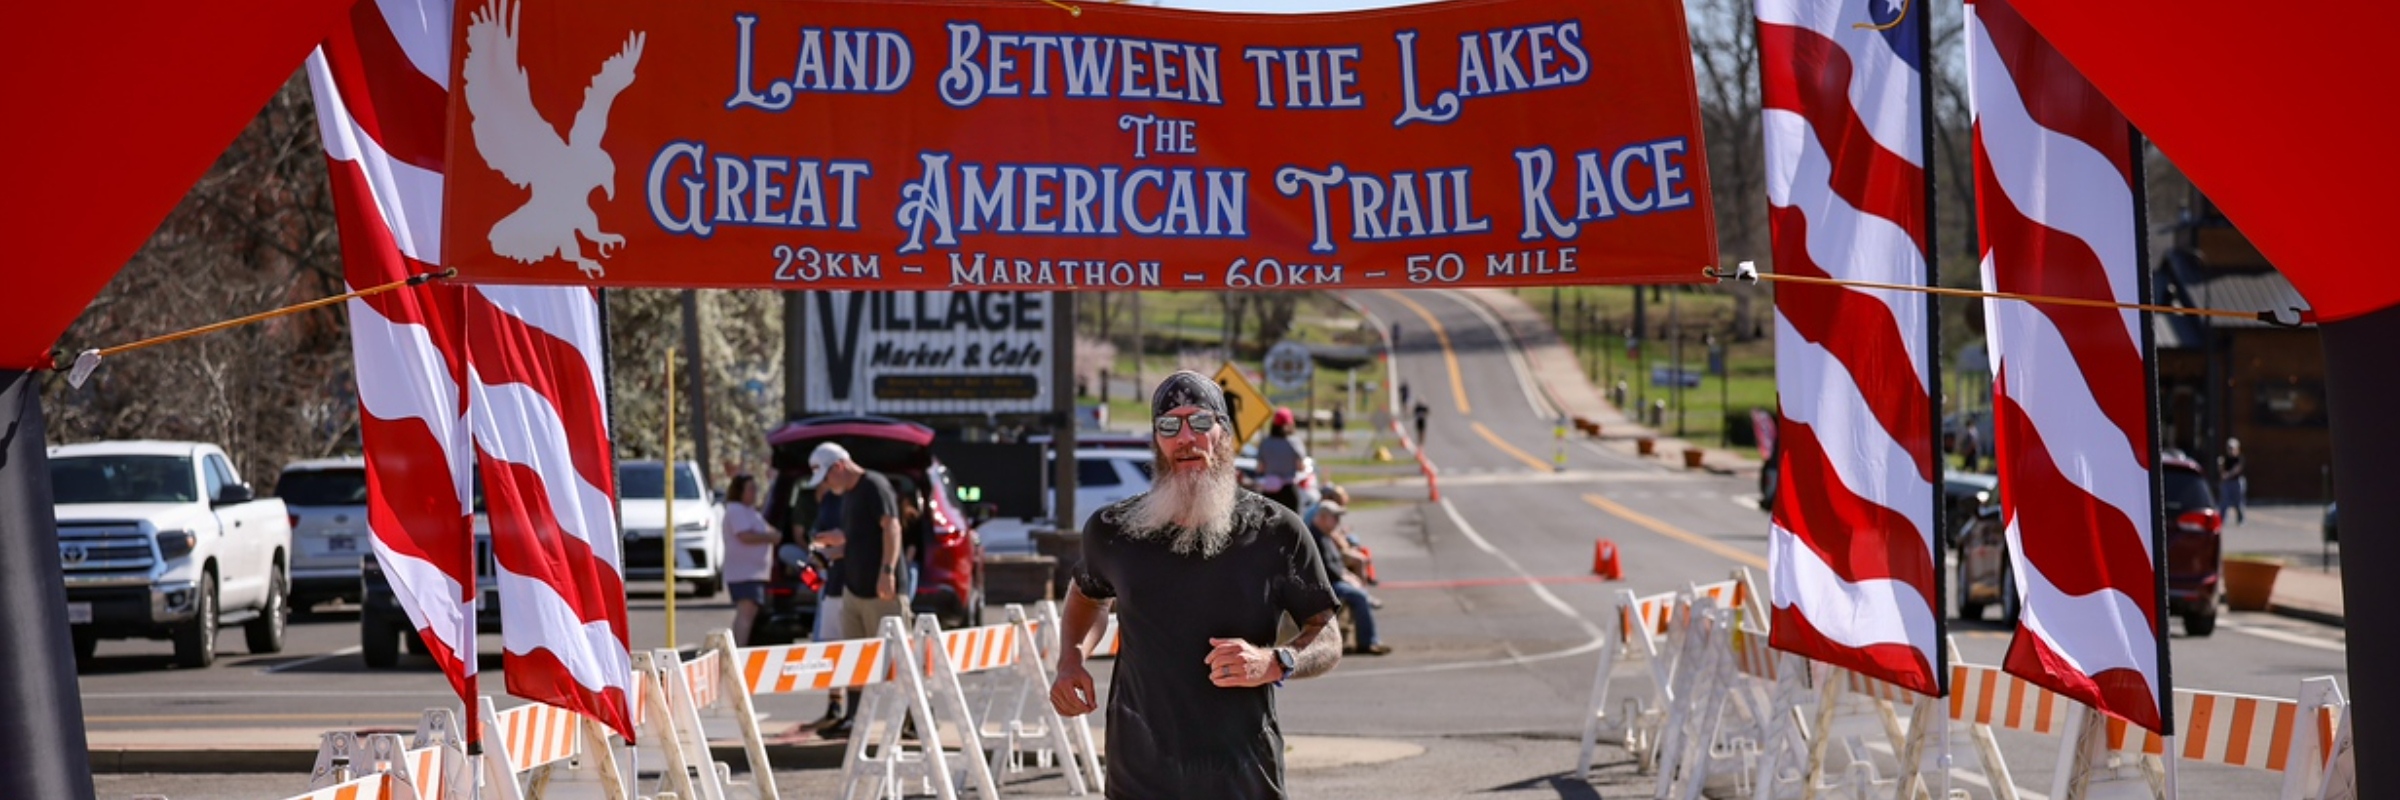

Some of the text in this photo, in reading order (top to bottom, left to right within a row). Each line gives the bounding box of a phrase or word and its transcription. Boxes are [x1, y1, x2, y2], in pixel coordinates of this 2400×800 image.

[726, 15, 1589, 126] LAND BETWEEN THE LAKES
[1119, 113, 1197, 159] THE
[648, 139, 1691, 253] GREAT AMERICAN TRAIL RACE
[949, 252, 1161, 286] MARATHON
[1407, 252, 1465, 284] 50
[1486, 247, 1578, 277] MILE
[814, 291, 1044, 401] VILLAGE
